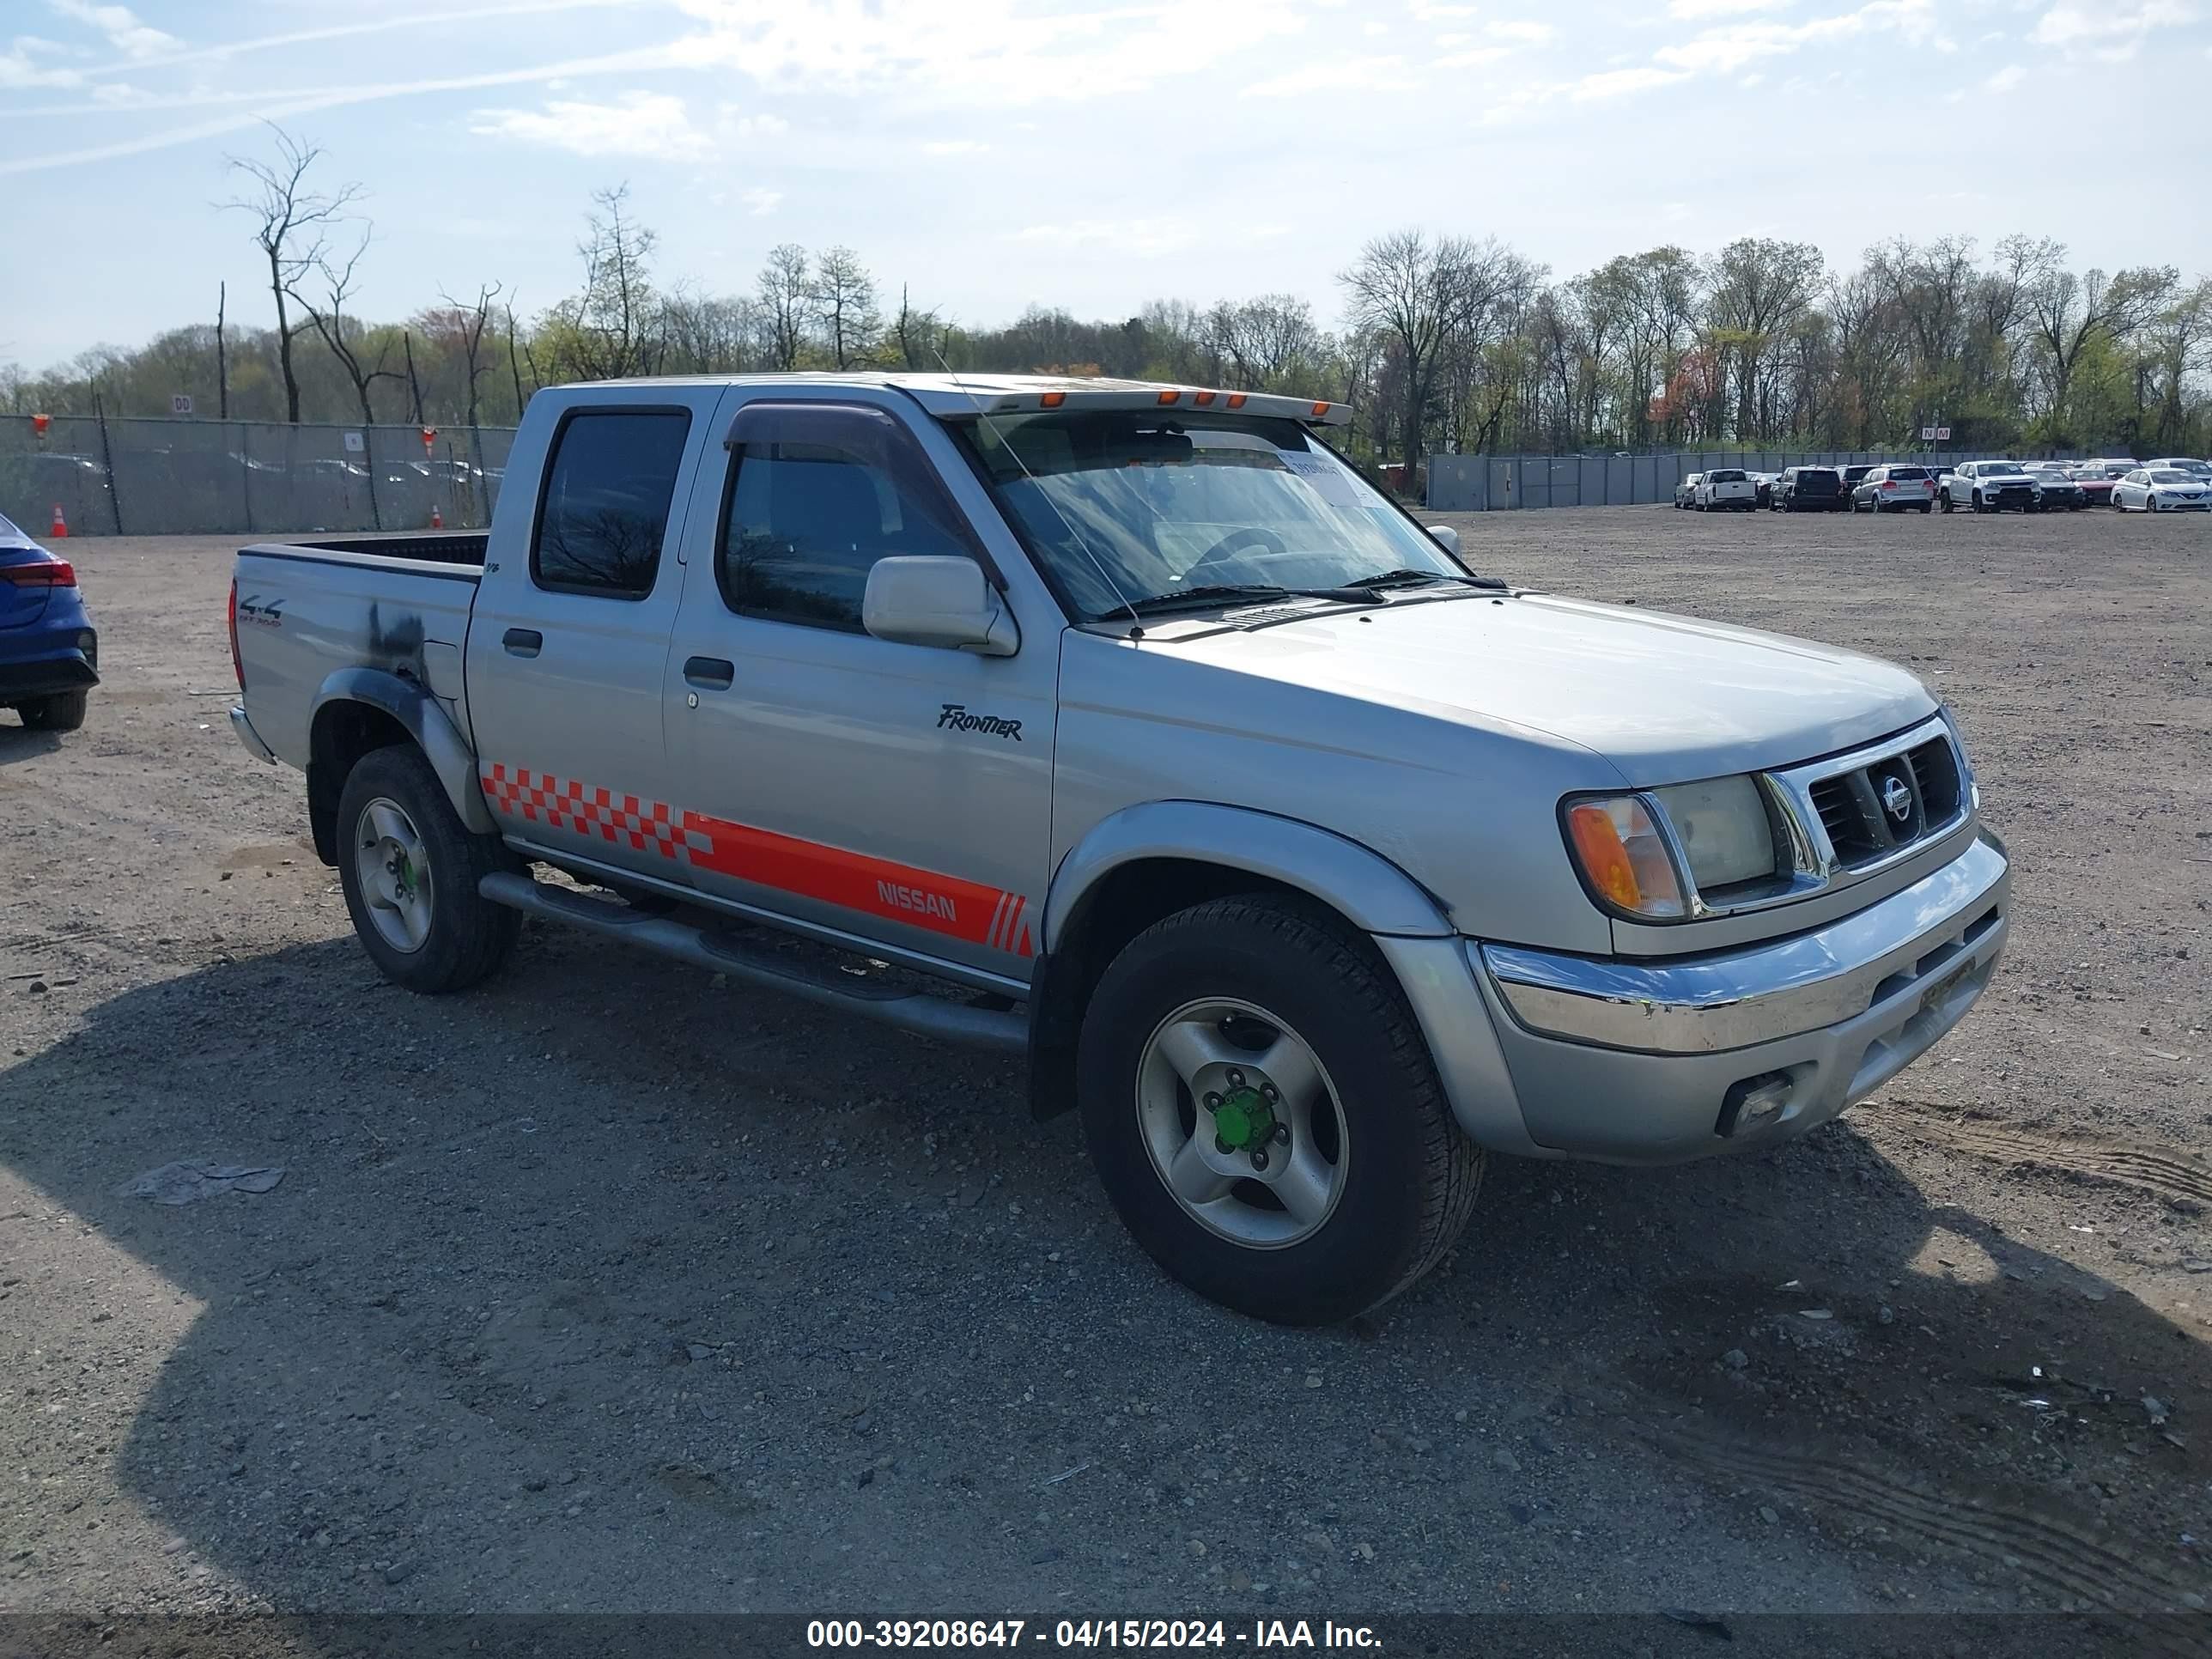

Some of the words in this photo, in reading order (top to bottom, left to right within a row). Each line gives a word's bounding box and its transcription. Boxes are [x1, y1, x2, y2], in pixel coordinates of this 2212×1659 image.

[1924, 429, 1933, 438] N
[1938, 429, 1949, 438] M
[877, 879, 957, 921] NISSAN
